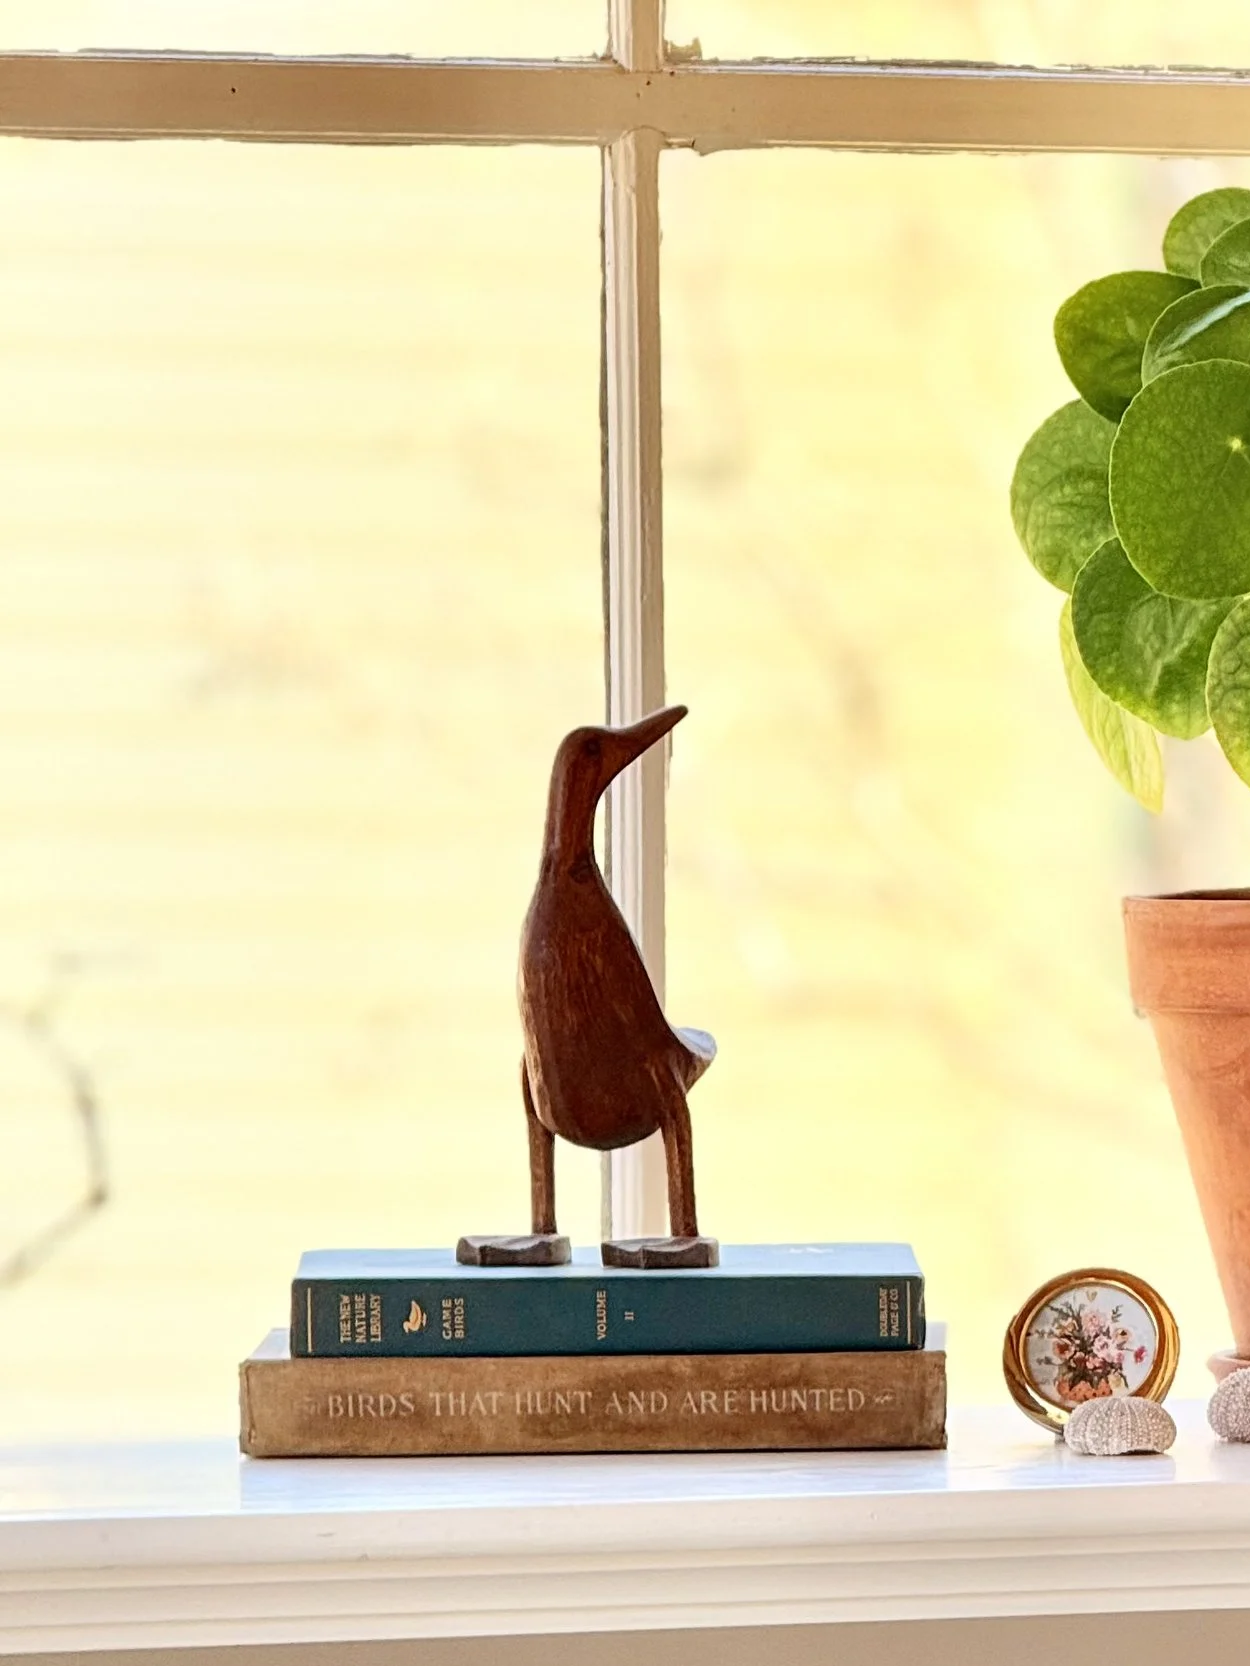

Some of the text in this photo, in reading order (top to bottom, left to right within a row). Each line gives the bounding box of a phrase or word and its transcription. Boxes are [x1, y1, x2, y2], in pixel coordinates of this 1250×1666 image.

[340, 1294, 351, 1343] THE NEW
[355, 1293, 366, 1343] NATURE
[370, 1293, 381, 1342] LIBRARY
[442, 1299, 452, 1340] GAME
[454, 1297, 464, 1339] BIRDS
[597, 1290, 606, 1340] VOLUME
[890, 1311, 898, 1336] PAGE
[327, 1388, 865, 1418] BIRDS THAT HUNT AND ARE HUNTED
